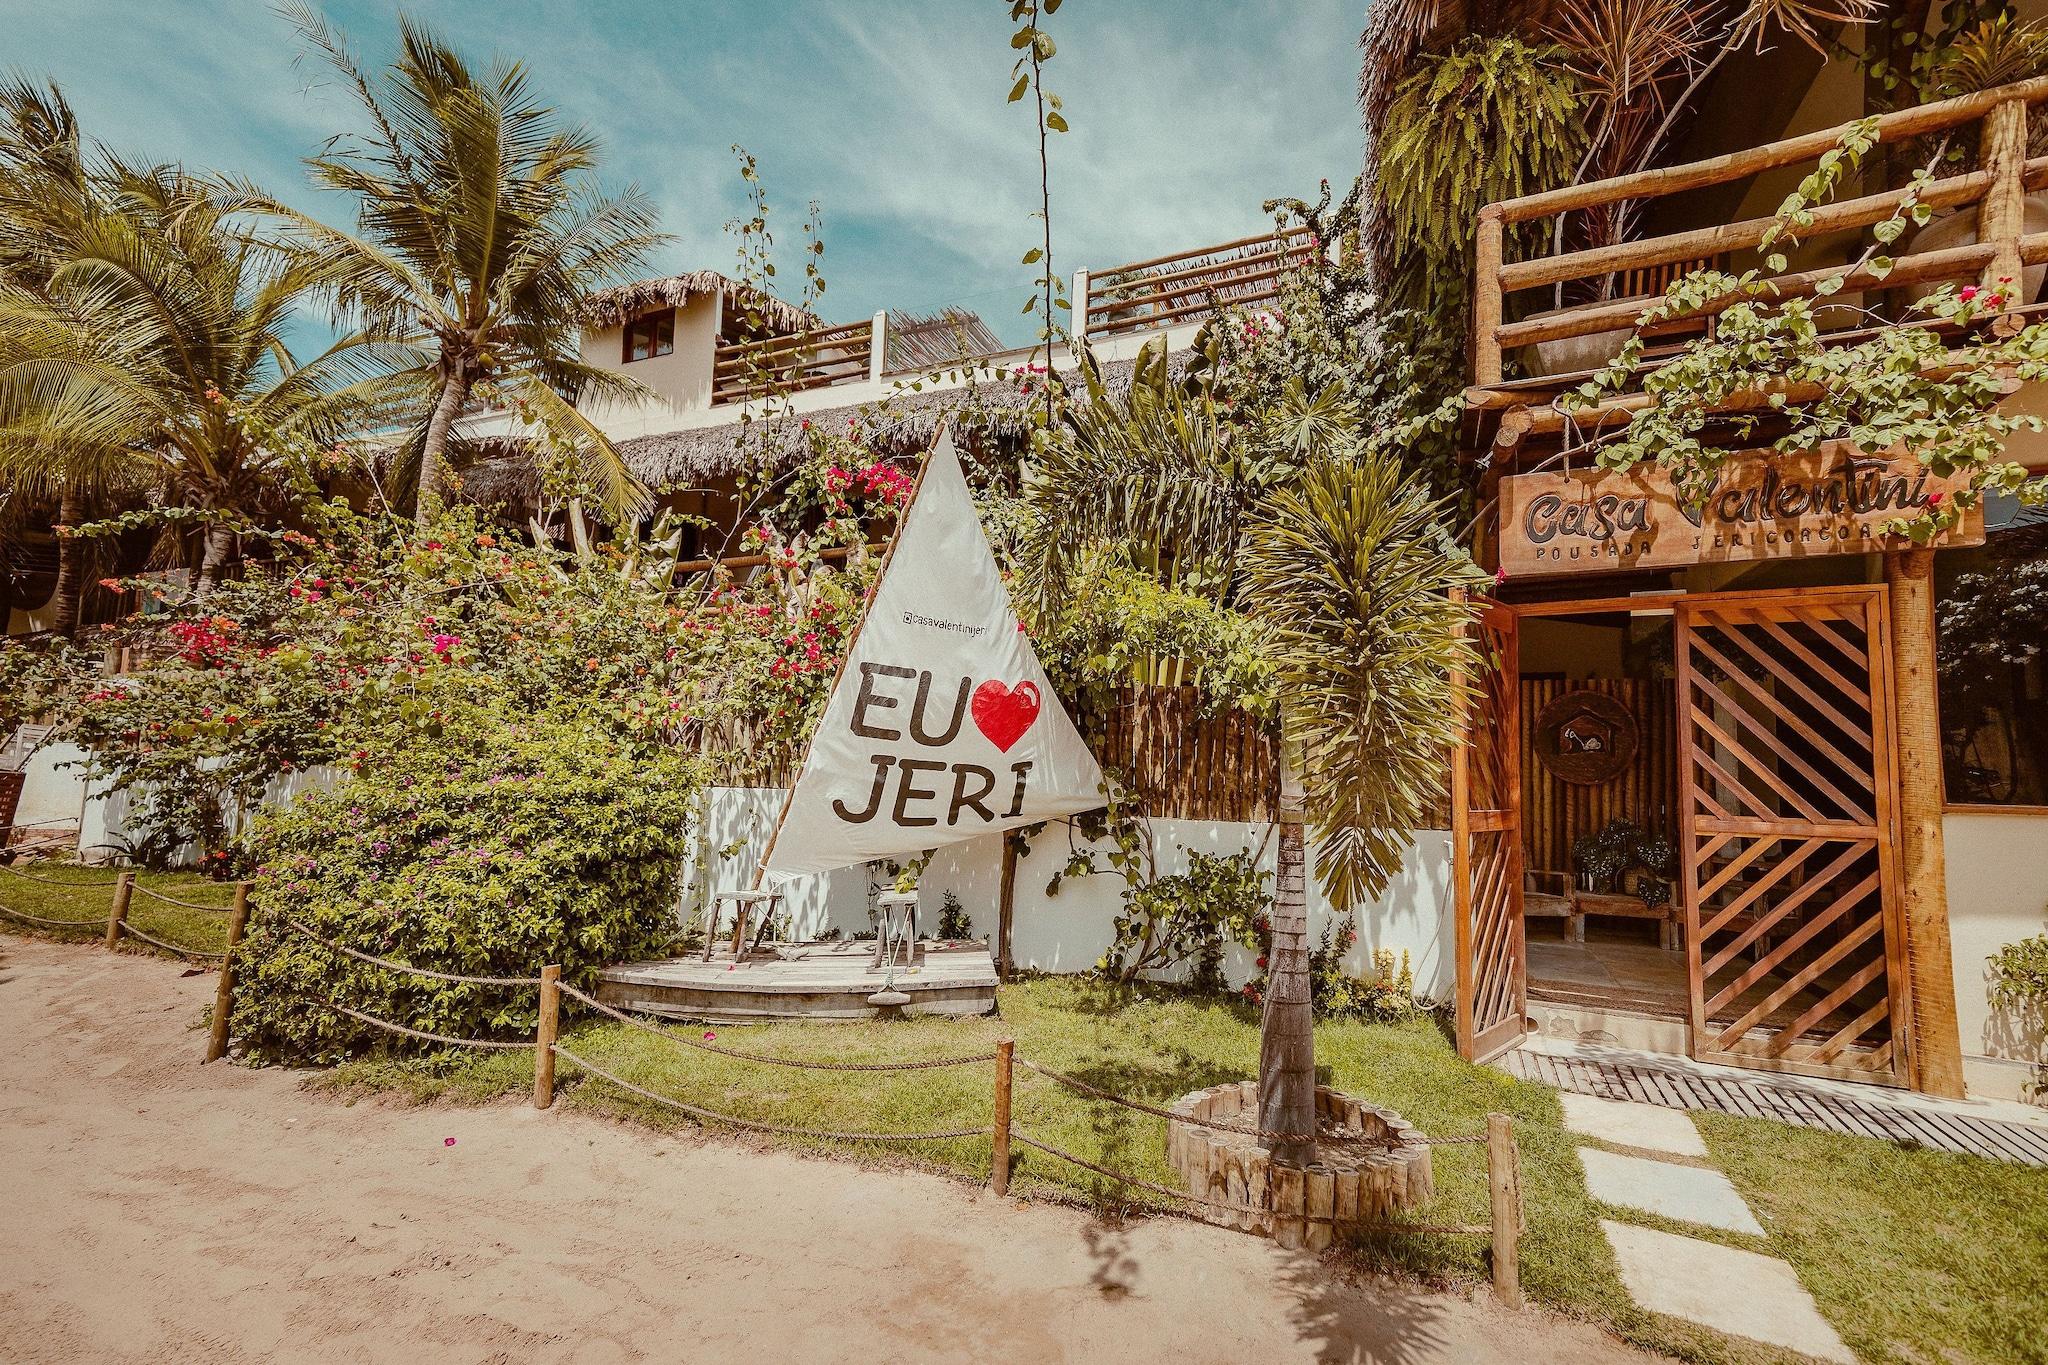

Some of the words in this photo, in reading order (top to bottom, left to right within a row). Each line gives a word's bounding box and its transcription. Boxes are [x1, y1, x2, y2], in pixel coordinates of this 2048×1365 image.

[1526, 494, 1651, 543] Casa
[1670, 456, 1930, 529] Valentini
[1536, 540, 1652, 560] POUSADA
[1691, 522, 1898, 550] JERICOACOA
[849, 661, 972, 747] EU
[832, 754, 1033, 827] JERI
